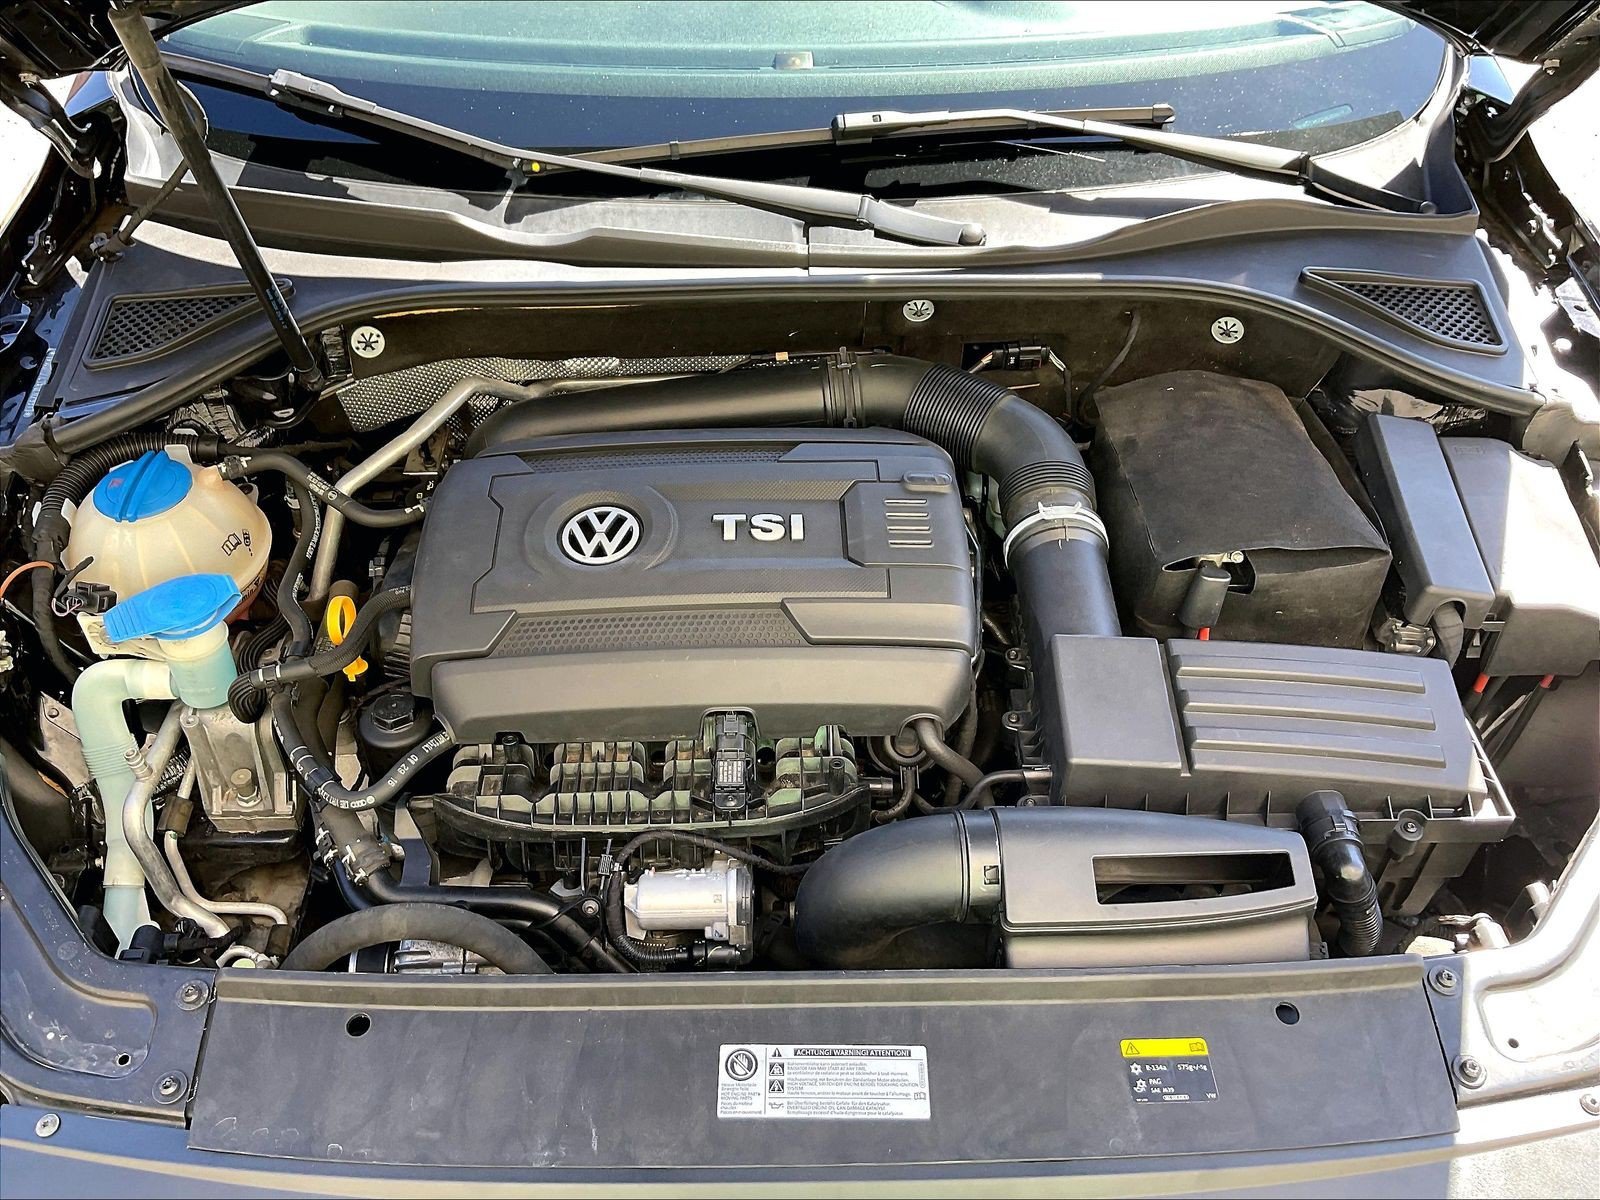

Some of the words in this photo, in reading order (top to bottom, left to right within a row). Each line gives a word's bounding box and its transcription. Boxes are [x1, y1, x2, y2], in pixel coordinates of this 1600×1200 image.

[711, 513, 805, 541] TSI
[397, 763, 409, 775] 29
[387, 777, 398, 787] 16
[796, 1048, 832, 1056] ACHTUNG!
